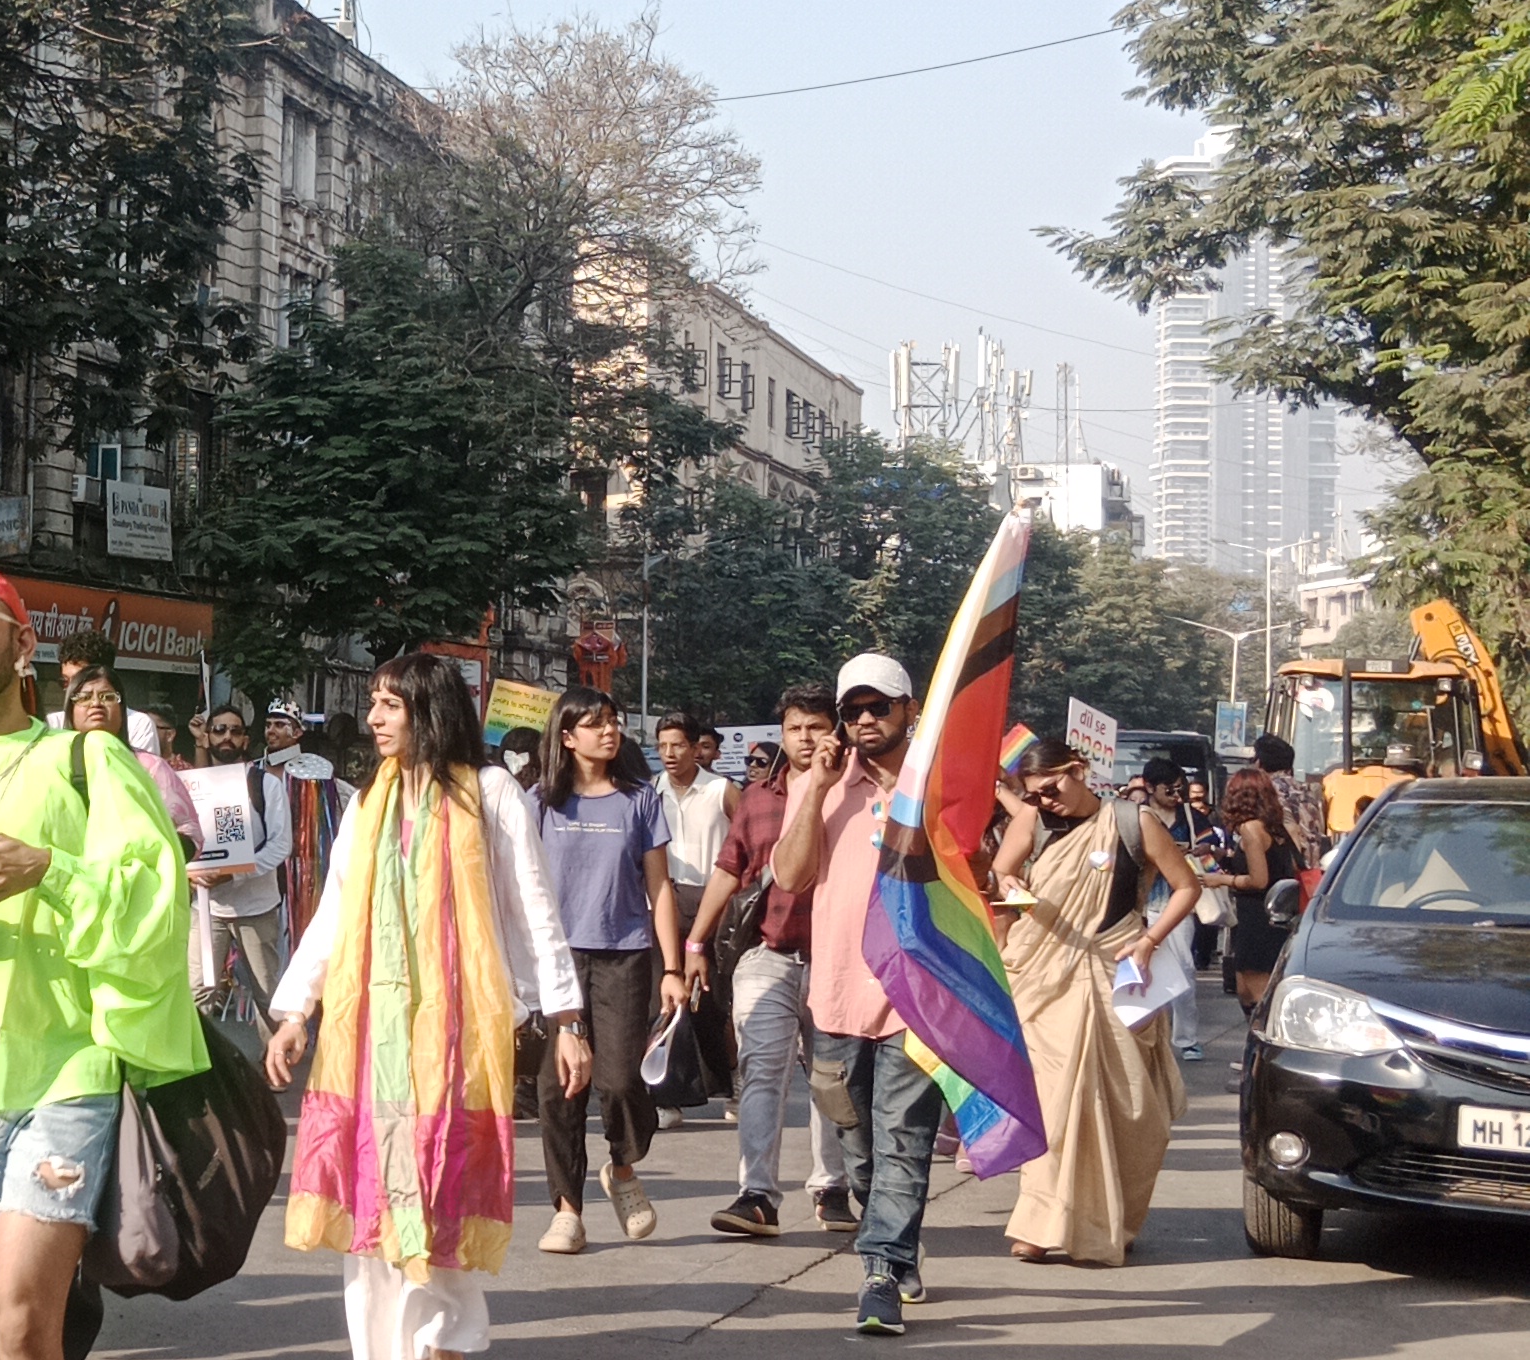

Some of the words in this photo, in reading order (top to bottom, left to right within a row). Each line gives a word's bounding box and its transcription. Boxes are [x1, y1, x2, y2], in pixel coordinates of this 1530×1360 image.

[119, 621, 162, 654] ICICI
[164, 627, 206, 657] Bank
[1079, 709, 1093, 729] dil
[1095, 719, 1106, 736] se
[1069, 728, 1113, 769] open
[1473, 1119, 1503, 1145] MH
